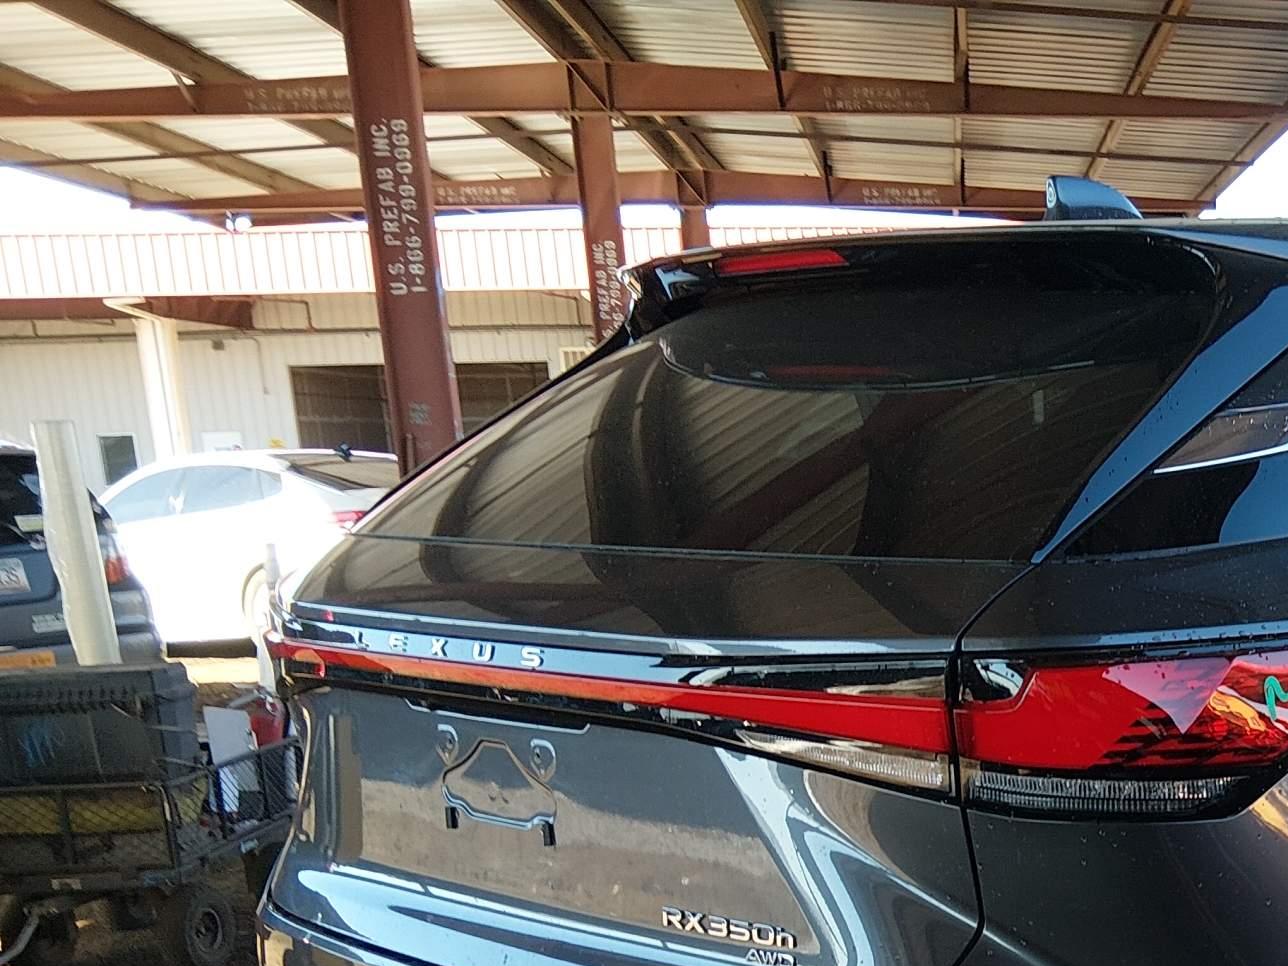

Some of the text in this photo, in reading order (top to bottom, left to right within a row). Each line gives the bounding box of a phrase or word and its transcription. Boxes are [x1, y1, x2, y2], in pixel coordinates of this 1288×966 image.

[375, 166, 401, 246] PREFAB
[390, 118, 429, 294] 1-866-799-0969
[388, 255, 409, 296] U.S.
[594, 269, 612, 320] PREFAB
[355, 630, 546, 668] LEXUS
[661, 905, 799, 950] RX350h
